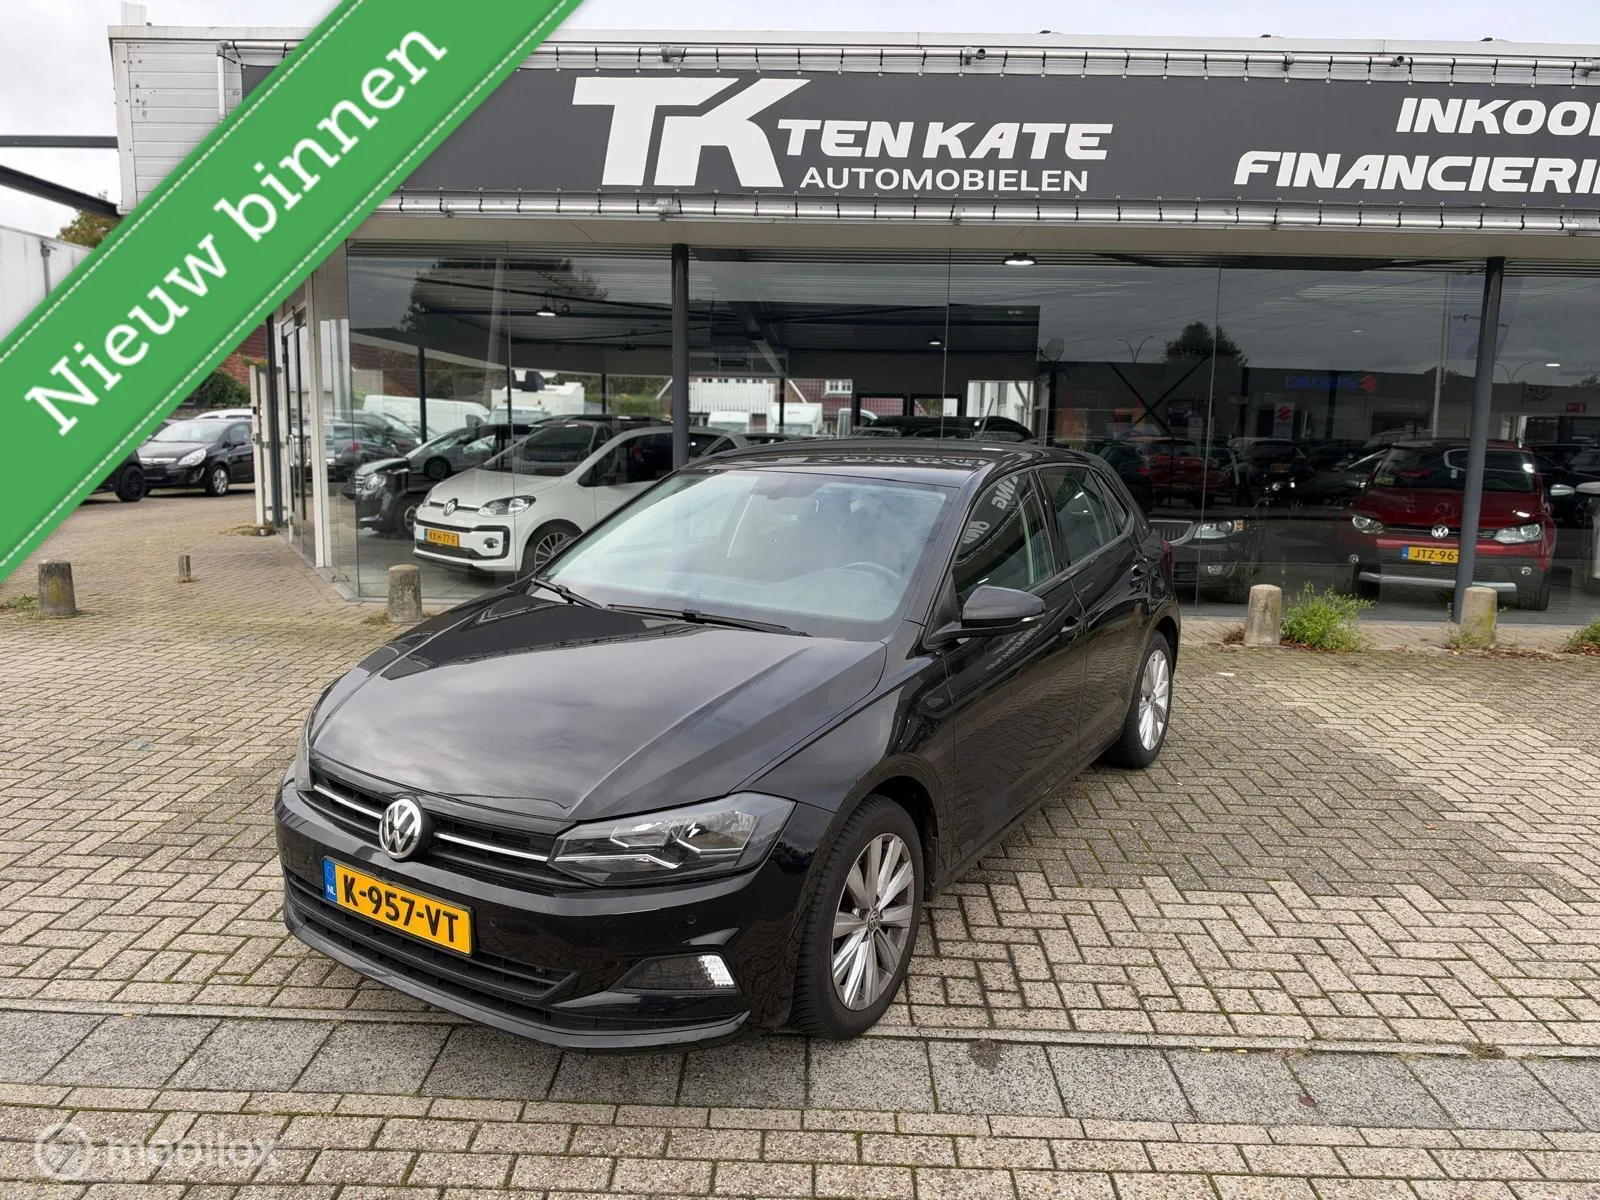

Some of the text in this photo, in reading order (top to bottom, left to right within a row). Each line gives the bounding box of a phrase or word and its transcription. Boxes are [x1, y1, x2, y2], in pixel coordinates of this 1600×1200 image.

[572, 76, 812, 188] TK
[1395, 97, 1600, 136] INKOO
[777, 118, 1113, 161] TEN KATE
[799, 166, 1088, 192] AUTOMOBIELEN
[1233, 149, 1600, 195] FINANCIERI
[1413, 549, 1460, 562] JTZ-96-
[342, 873, 459, 943] K-957-VT
